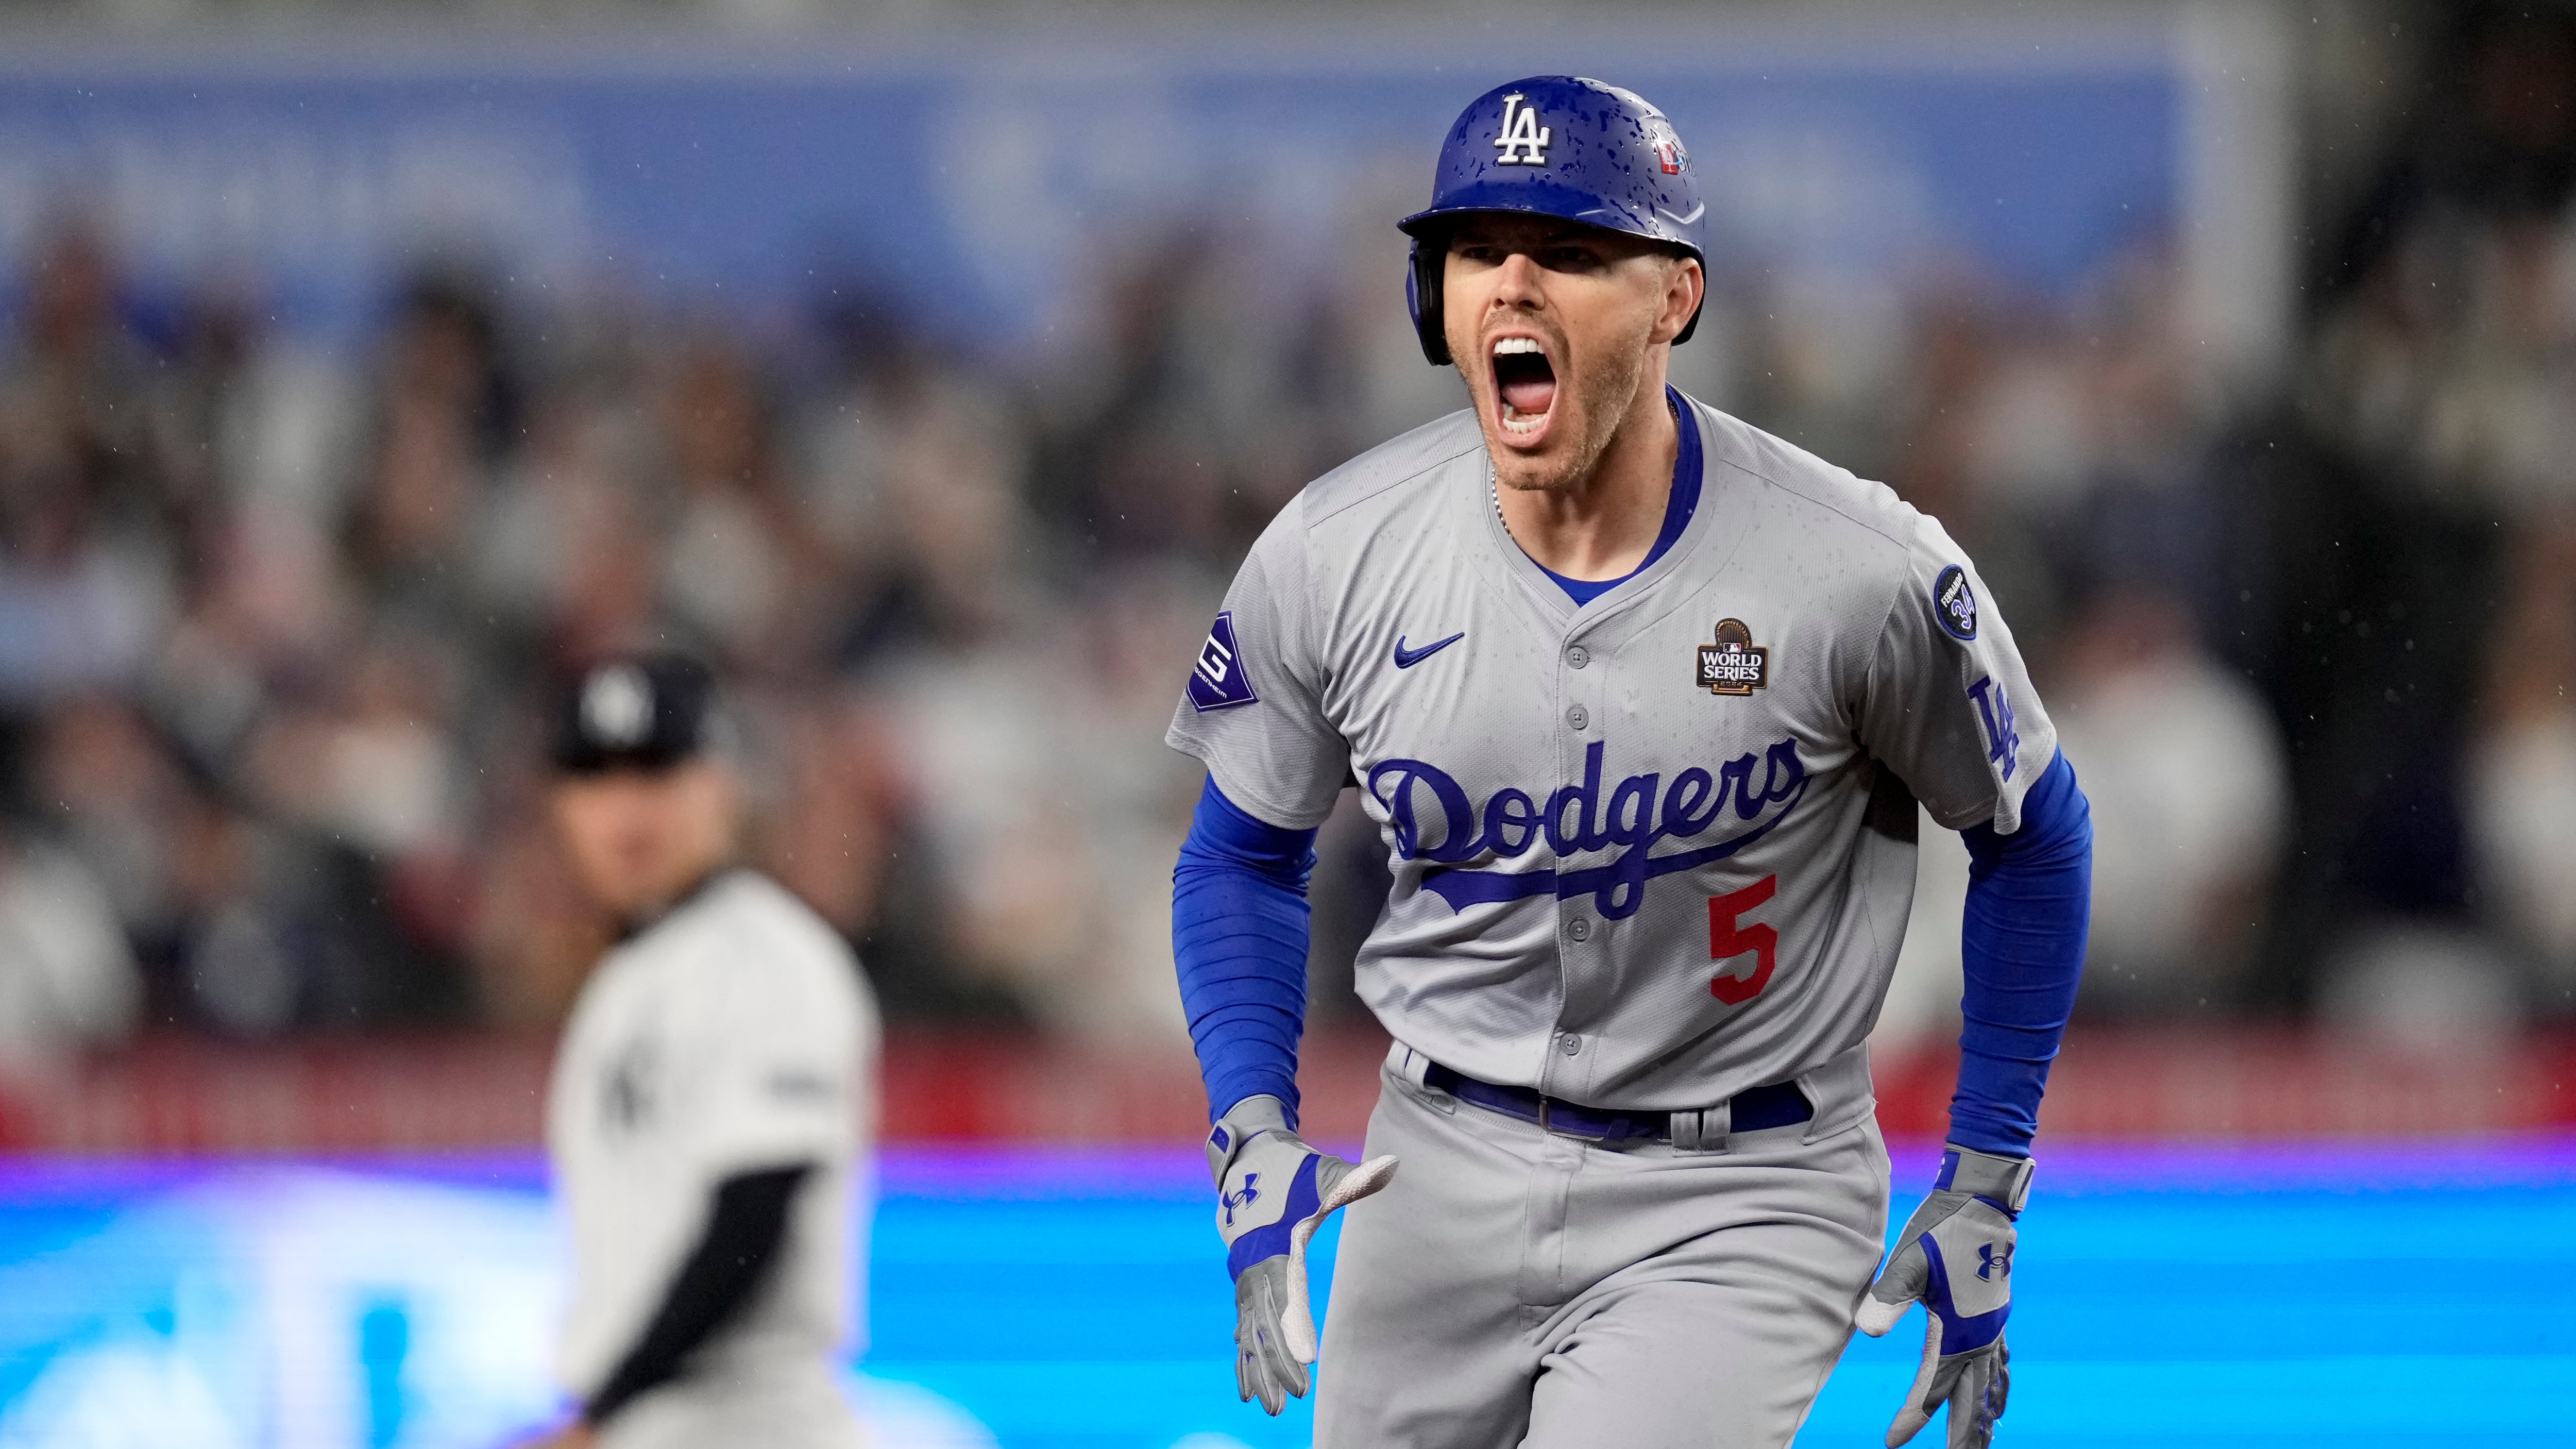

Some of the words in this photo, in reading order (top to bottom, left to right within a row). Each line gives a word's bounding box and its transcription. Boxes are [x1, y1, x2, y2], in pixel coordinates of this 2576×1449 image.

[1495, 94, 1550, 165] LA
[1940, 572, 1963, 608] FERNANDO
[1951, 584, 1975, 629] 34
[1702, 652, 1762, 667] WORLD
[1704, 665, 1760, 681] SERIES
[1195, 666, 1227, 698] GGENHEIM
[1368, 738, 1808, 921] Dodgers
[1708, 873, 1778, 1005] 5
